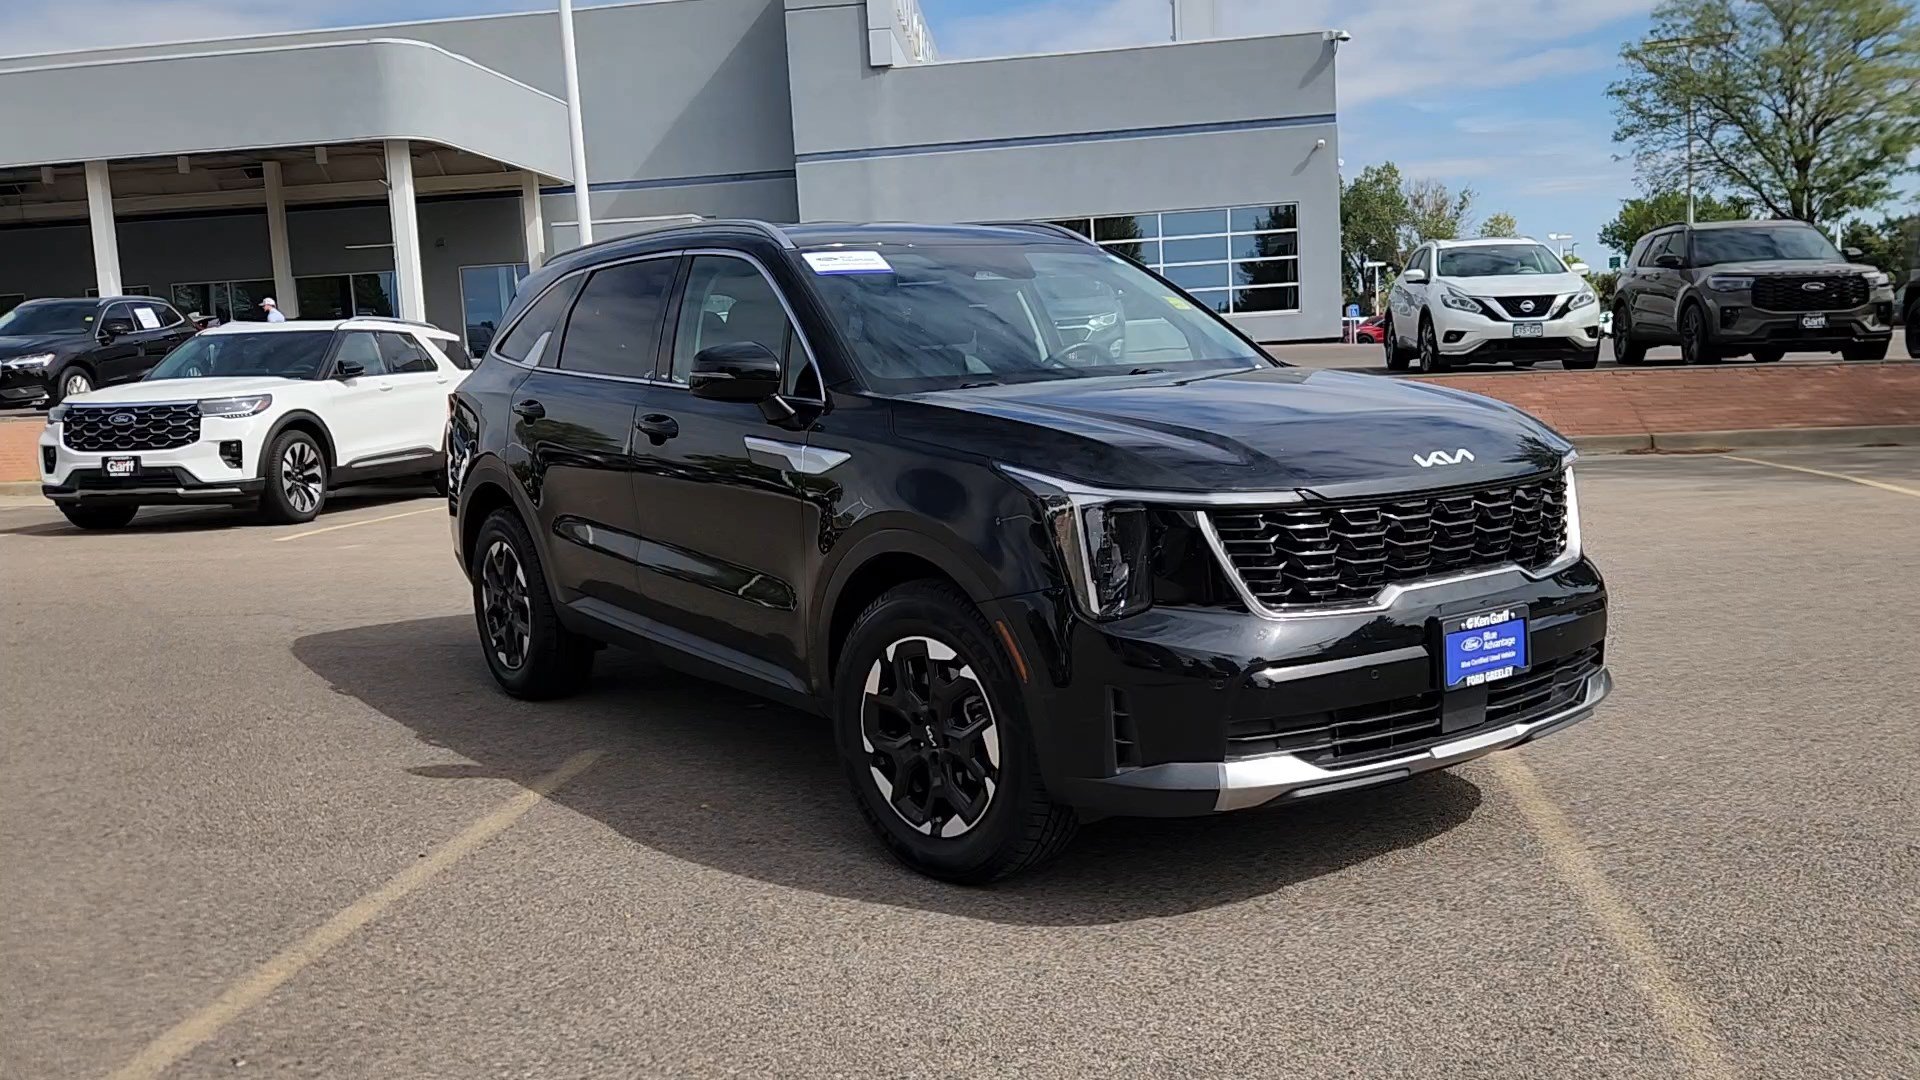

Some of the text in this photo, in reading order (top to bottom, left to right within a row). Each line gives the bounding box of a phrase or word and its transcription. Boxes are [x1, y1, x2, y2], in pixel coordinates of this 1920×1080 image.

[1412, 447, 1475, 468] KIA
[106, 460, 135, 473] Garff
[1483, 631, 1498, 641] Blue
[1483, 637, 1516, 650] Advantage
[1466, 673, 1485, 687] FORD
